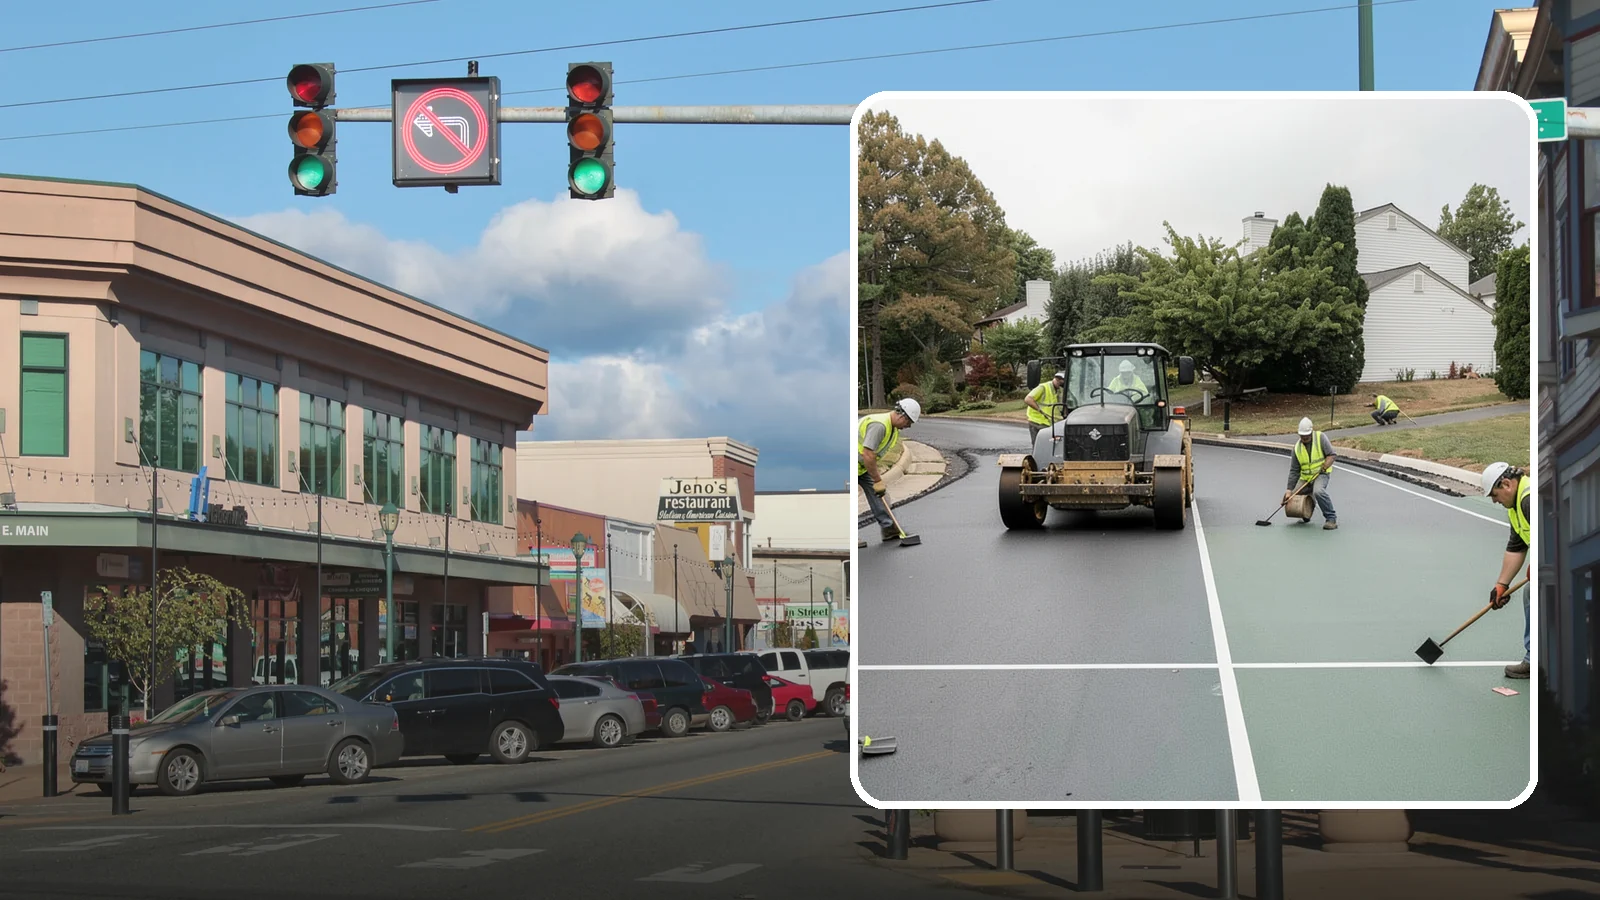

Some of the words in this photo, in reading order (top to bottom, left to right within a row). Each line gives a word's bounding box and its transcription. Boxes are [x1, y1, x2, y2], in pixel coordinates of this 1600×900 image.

[670, 480, 727, 494] Jeno's
[665, 496, 731, 509] restaurant
[659, 510, 681, 519] Italian
[686, 509, 714, 519] American
[715, 510, 737, 519] Cuisine
[2, 525, 13, 536] E.
[15, 525, 49, 536] MAIN
[797, 607, 829, 617] Street
